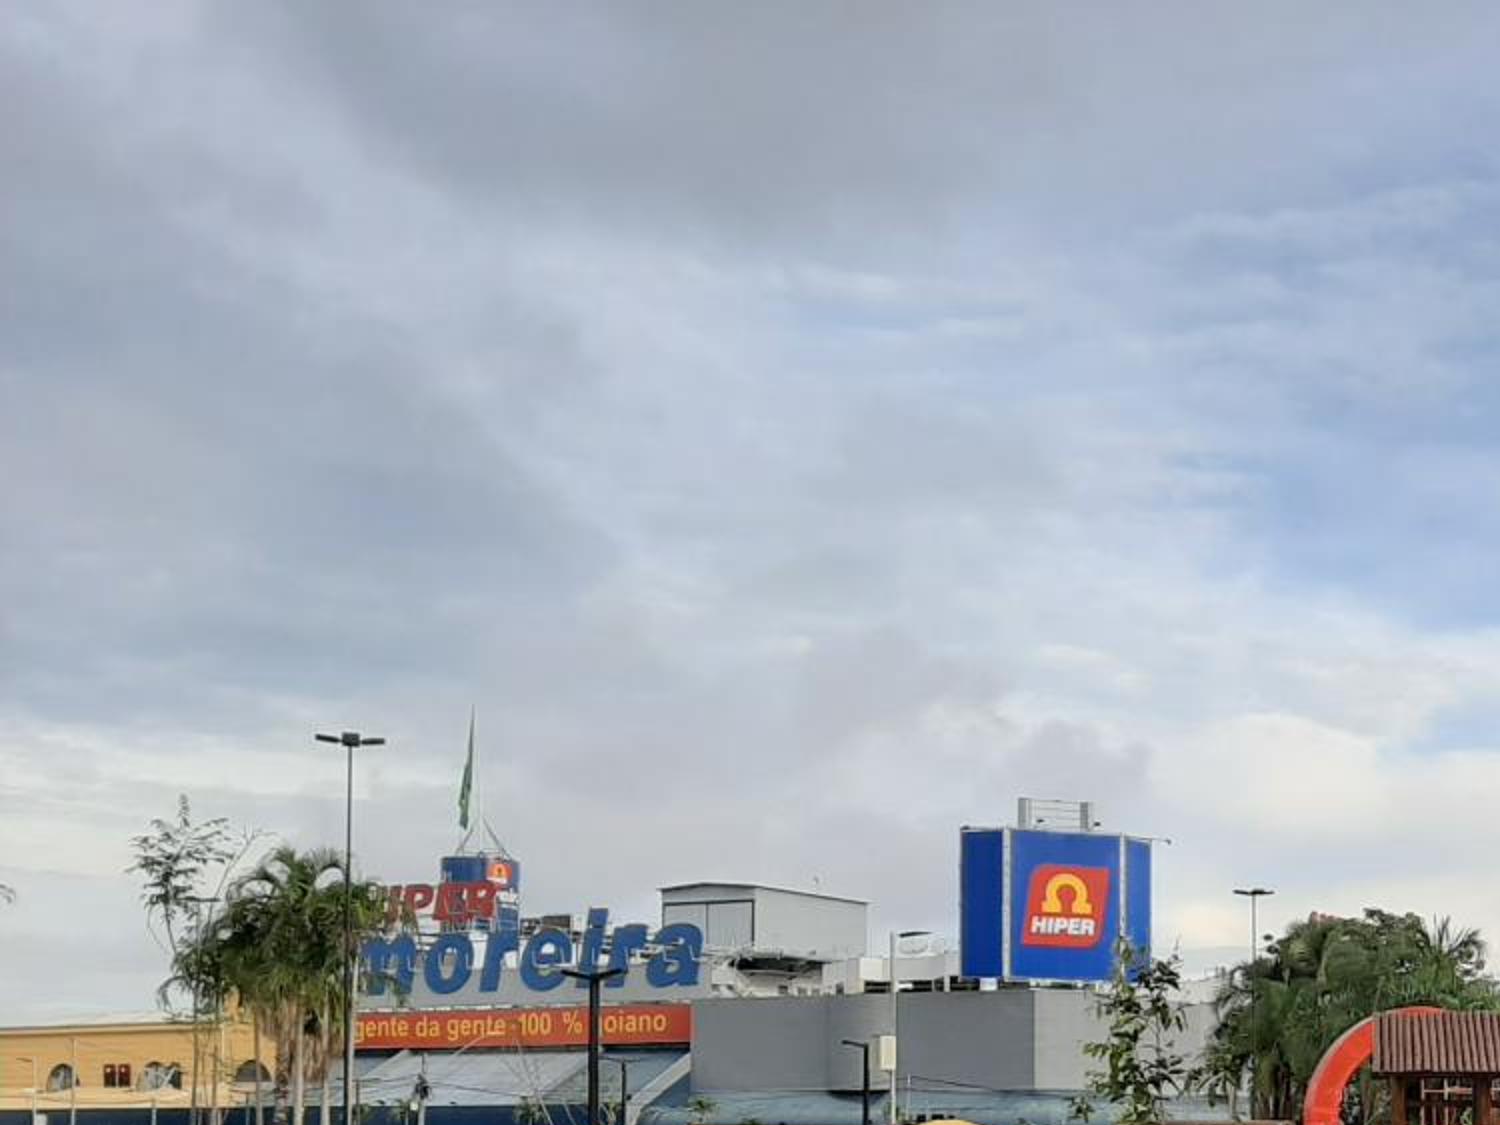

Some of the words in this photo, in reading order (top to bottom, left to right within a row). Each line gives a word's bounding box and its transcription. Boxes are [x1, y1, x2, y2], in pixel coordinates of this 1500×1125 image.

[1031, 915, 1095, 935] HIPER
[358, 907, 704, 996] moreira
[355, 1015, 409, 1042] gente
[415, 1015, 440, 1037] da
[447, 1015, 506, 1041] gente
[517, 1011, 550, 1037] 100
[562, 1009, 583, 1035] %
[597, 1010, 667, 1035] oiano
